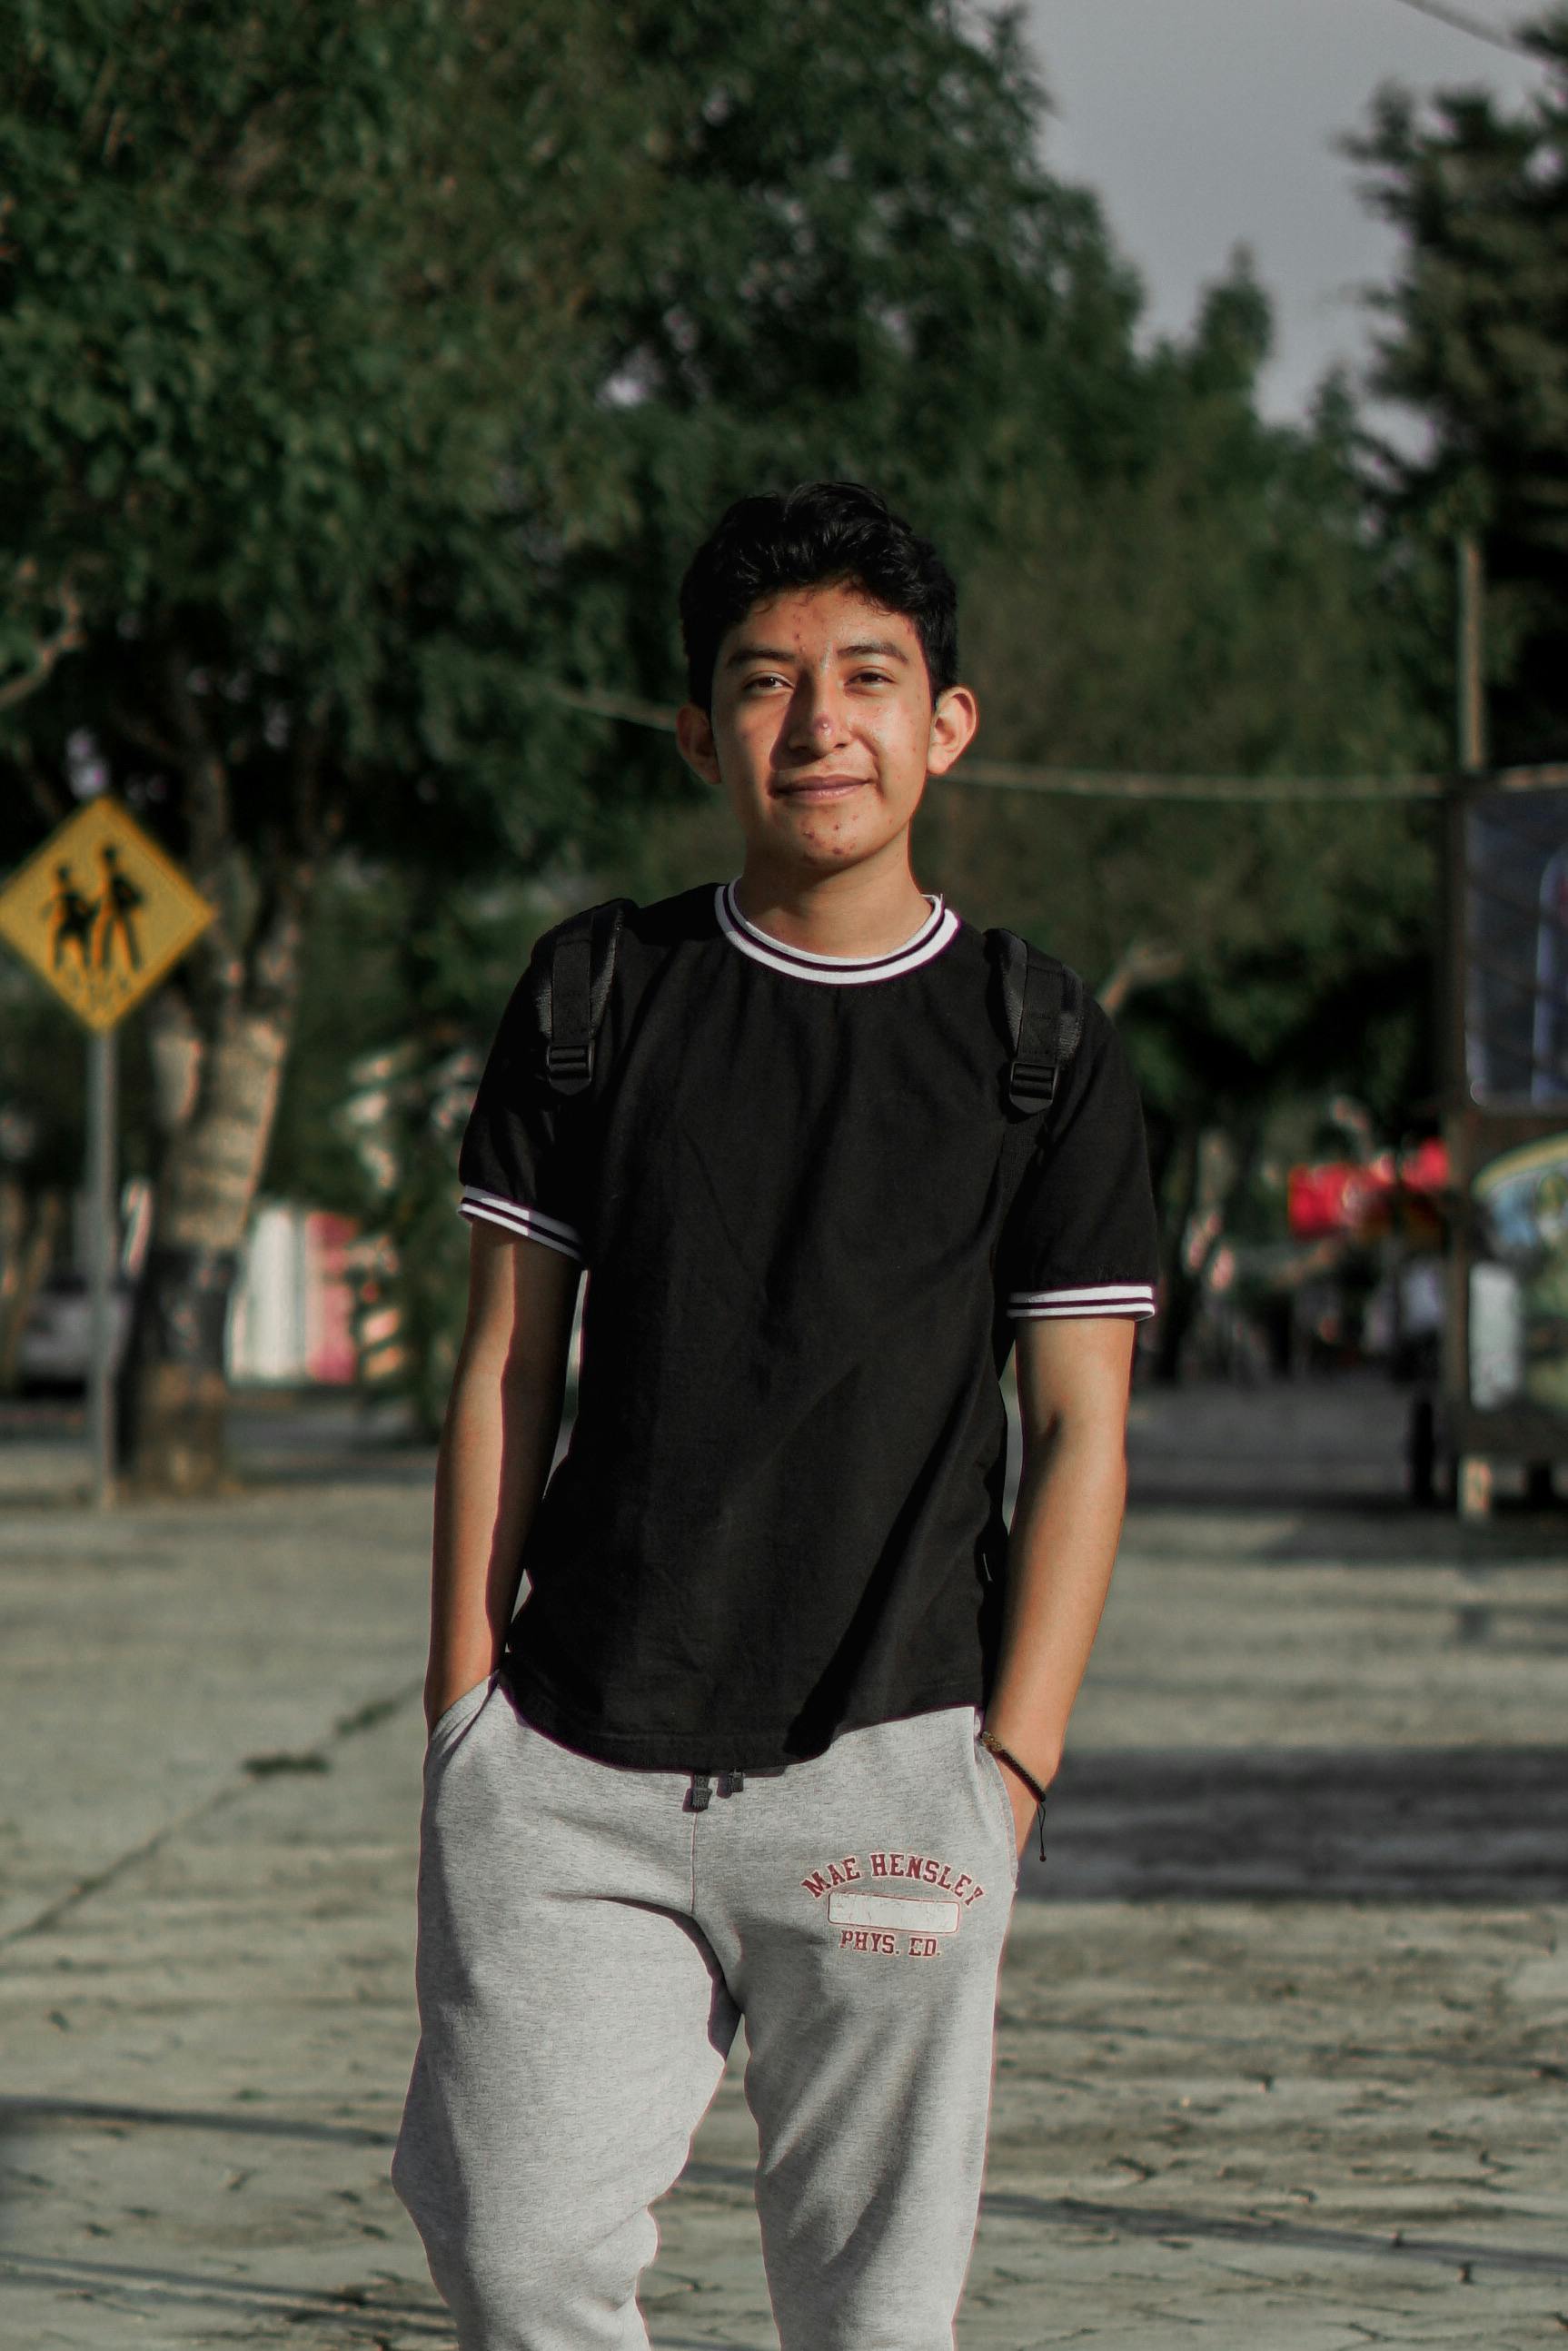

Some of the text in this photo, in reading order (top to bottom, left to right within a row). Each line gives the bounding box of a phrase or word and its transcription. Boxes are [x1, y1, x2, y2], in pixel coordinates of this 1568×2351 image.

[800, 1852, 984, 1906] MAE HENSLEY
[839, 1929, 941, 1958] PHYS. ED.
